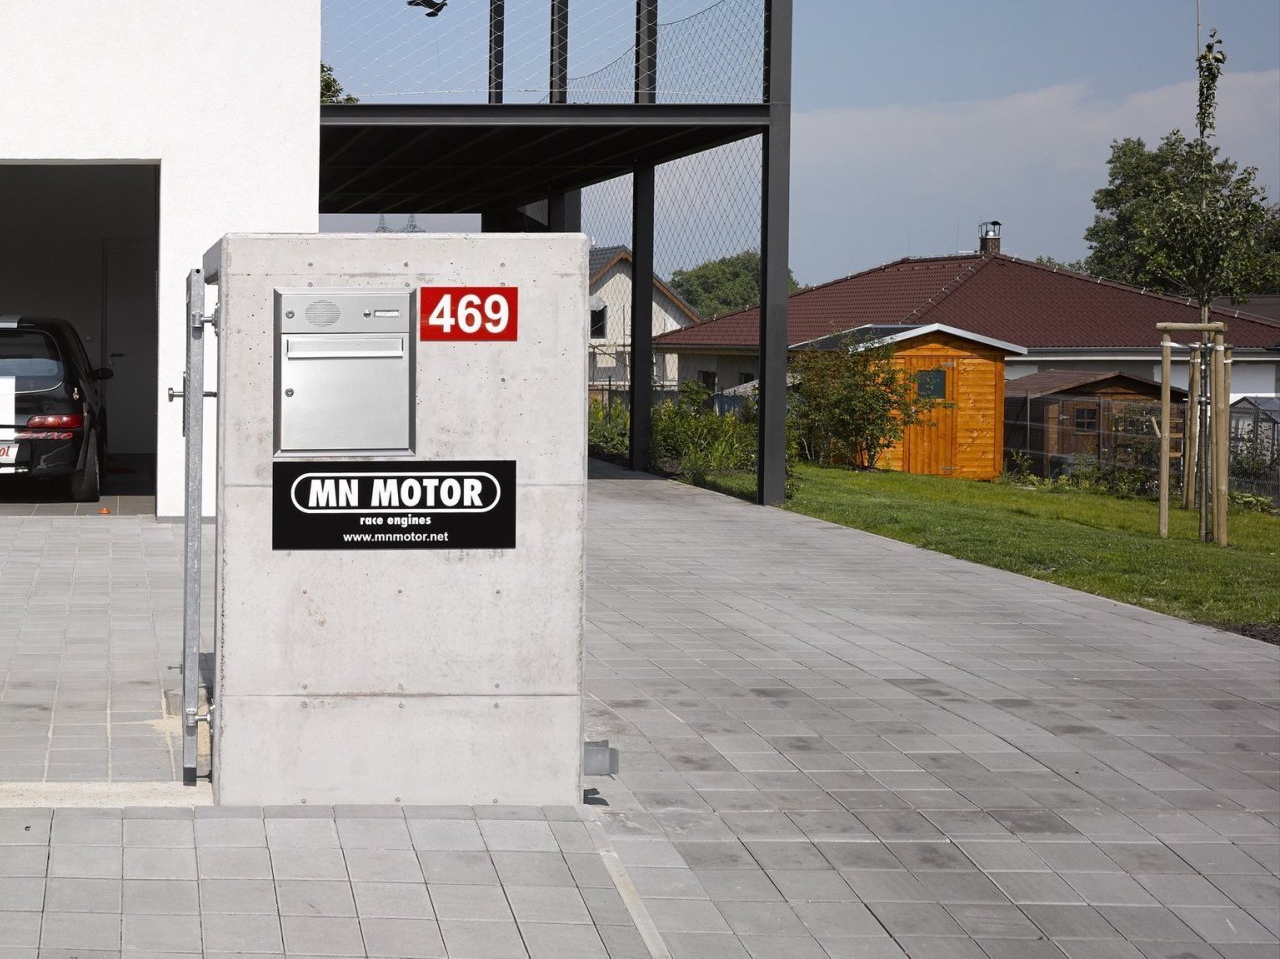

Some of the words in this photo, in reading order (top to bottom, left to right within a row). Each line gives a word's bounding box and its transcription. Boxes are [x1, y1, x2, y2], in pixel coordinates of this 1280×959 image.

[429, 294, 509, 334] 469
[308, 479, 359, 507] MN
[371, 478, 483, 507] MOTOR
[360, 516, 383, 525] race
[387, 514, 431, 528] engines
[343, 532, 448, 542] www.mnmotor.net
